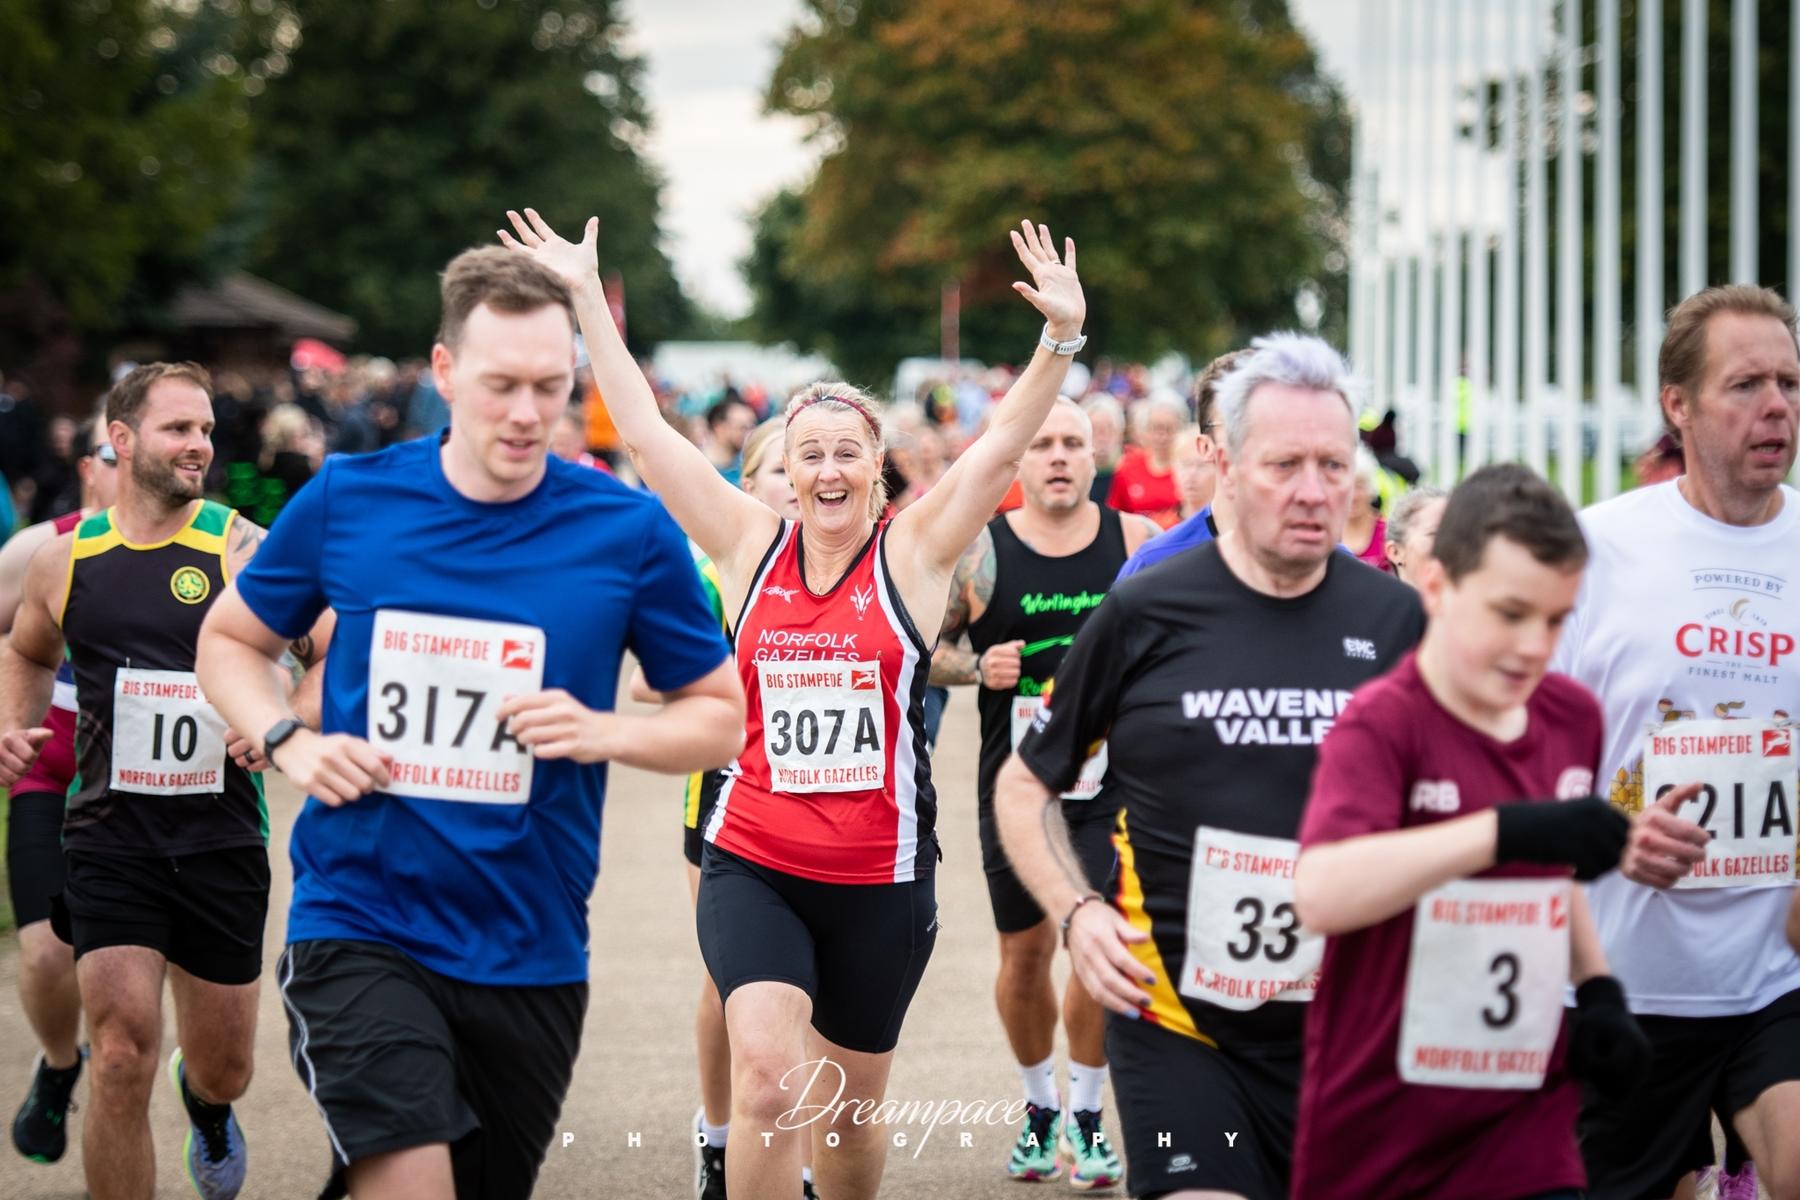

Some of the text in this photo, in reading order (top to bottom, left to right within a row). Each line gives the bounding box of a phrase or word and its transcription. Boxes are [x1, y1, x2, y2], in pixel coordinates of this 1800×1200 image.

[1694, 574, 1784, 593] POWERED BY
[383, 630, 490, 660] BIG STAMPEDE
[758, 629, 858, 648] NORFOLK
[1675, 622, 1796, 667] CRISP
[755, 648, 860, 662] GAZELLES
[766, 672, 843, 688] BIG STAMPEDE
[1688, 666, 1779, 685] FINEST MALT
[122, 681, 198, 700] BIG STAMPEDE
[152, 713, 198, 762] 10
[771, 707, 880, 756] 307A
[1653, 735, 1753, 756] BIG STAMPEDE
[119, 768, 217, 786] NORFOLK GAZELLES
[381, 757, 521, 792] RFOLK GAZELLES
[824, 765, 878, 784] GAZELLES
[1656, 780, 1794, 839] 21A
[1206, 847, 1231, 869] BG
[1724, 855, 1790, 877] GAZELLES
[1431, 898, 1461, 926] BIG
[1227, 896, 1302, 963] 33
[1194, 966, 1256, 999] NRFOLK
[1481, 951, 1521, 1031] 3
[1415, 1046, 1491, 1073] NORFOLK
